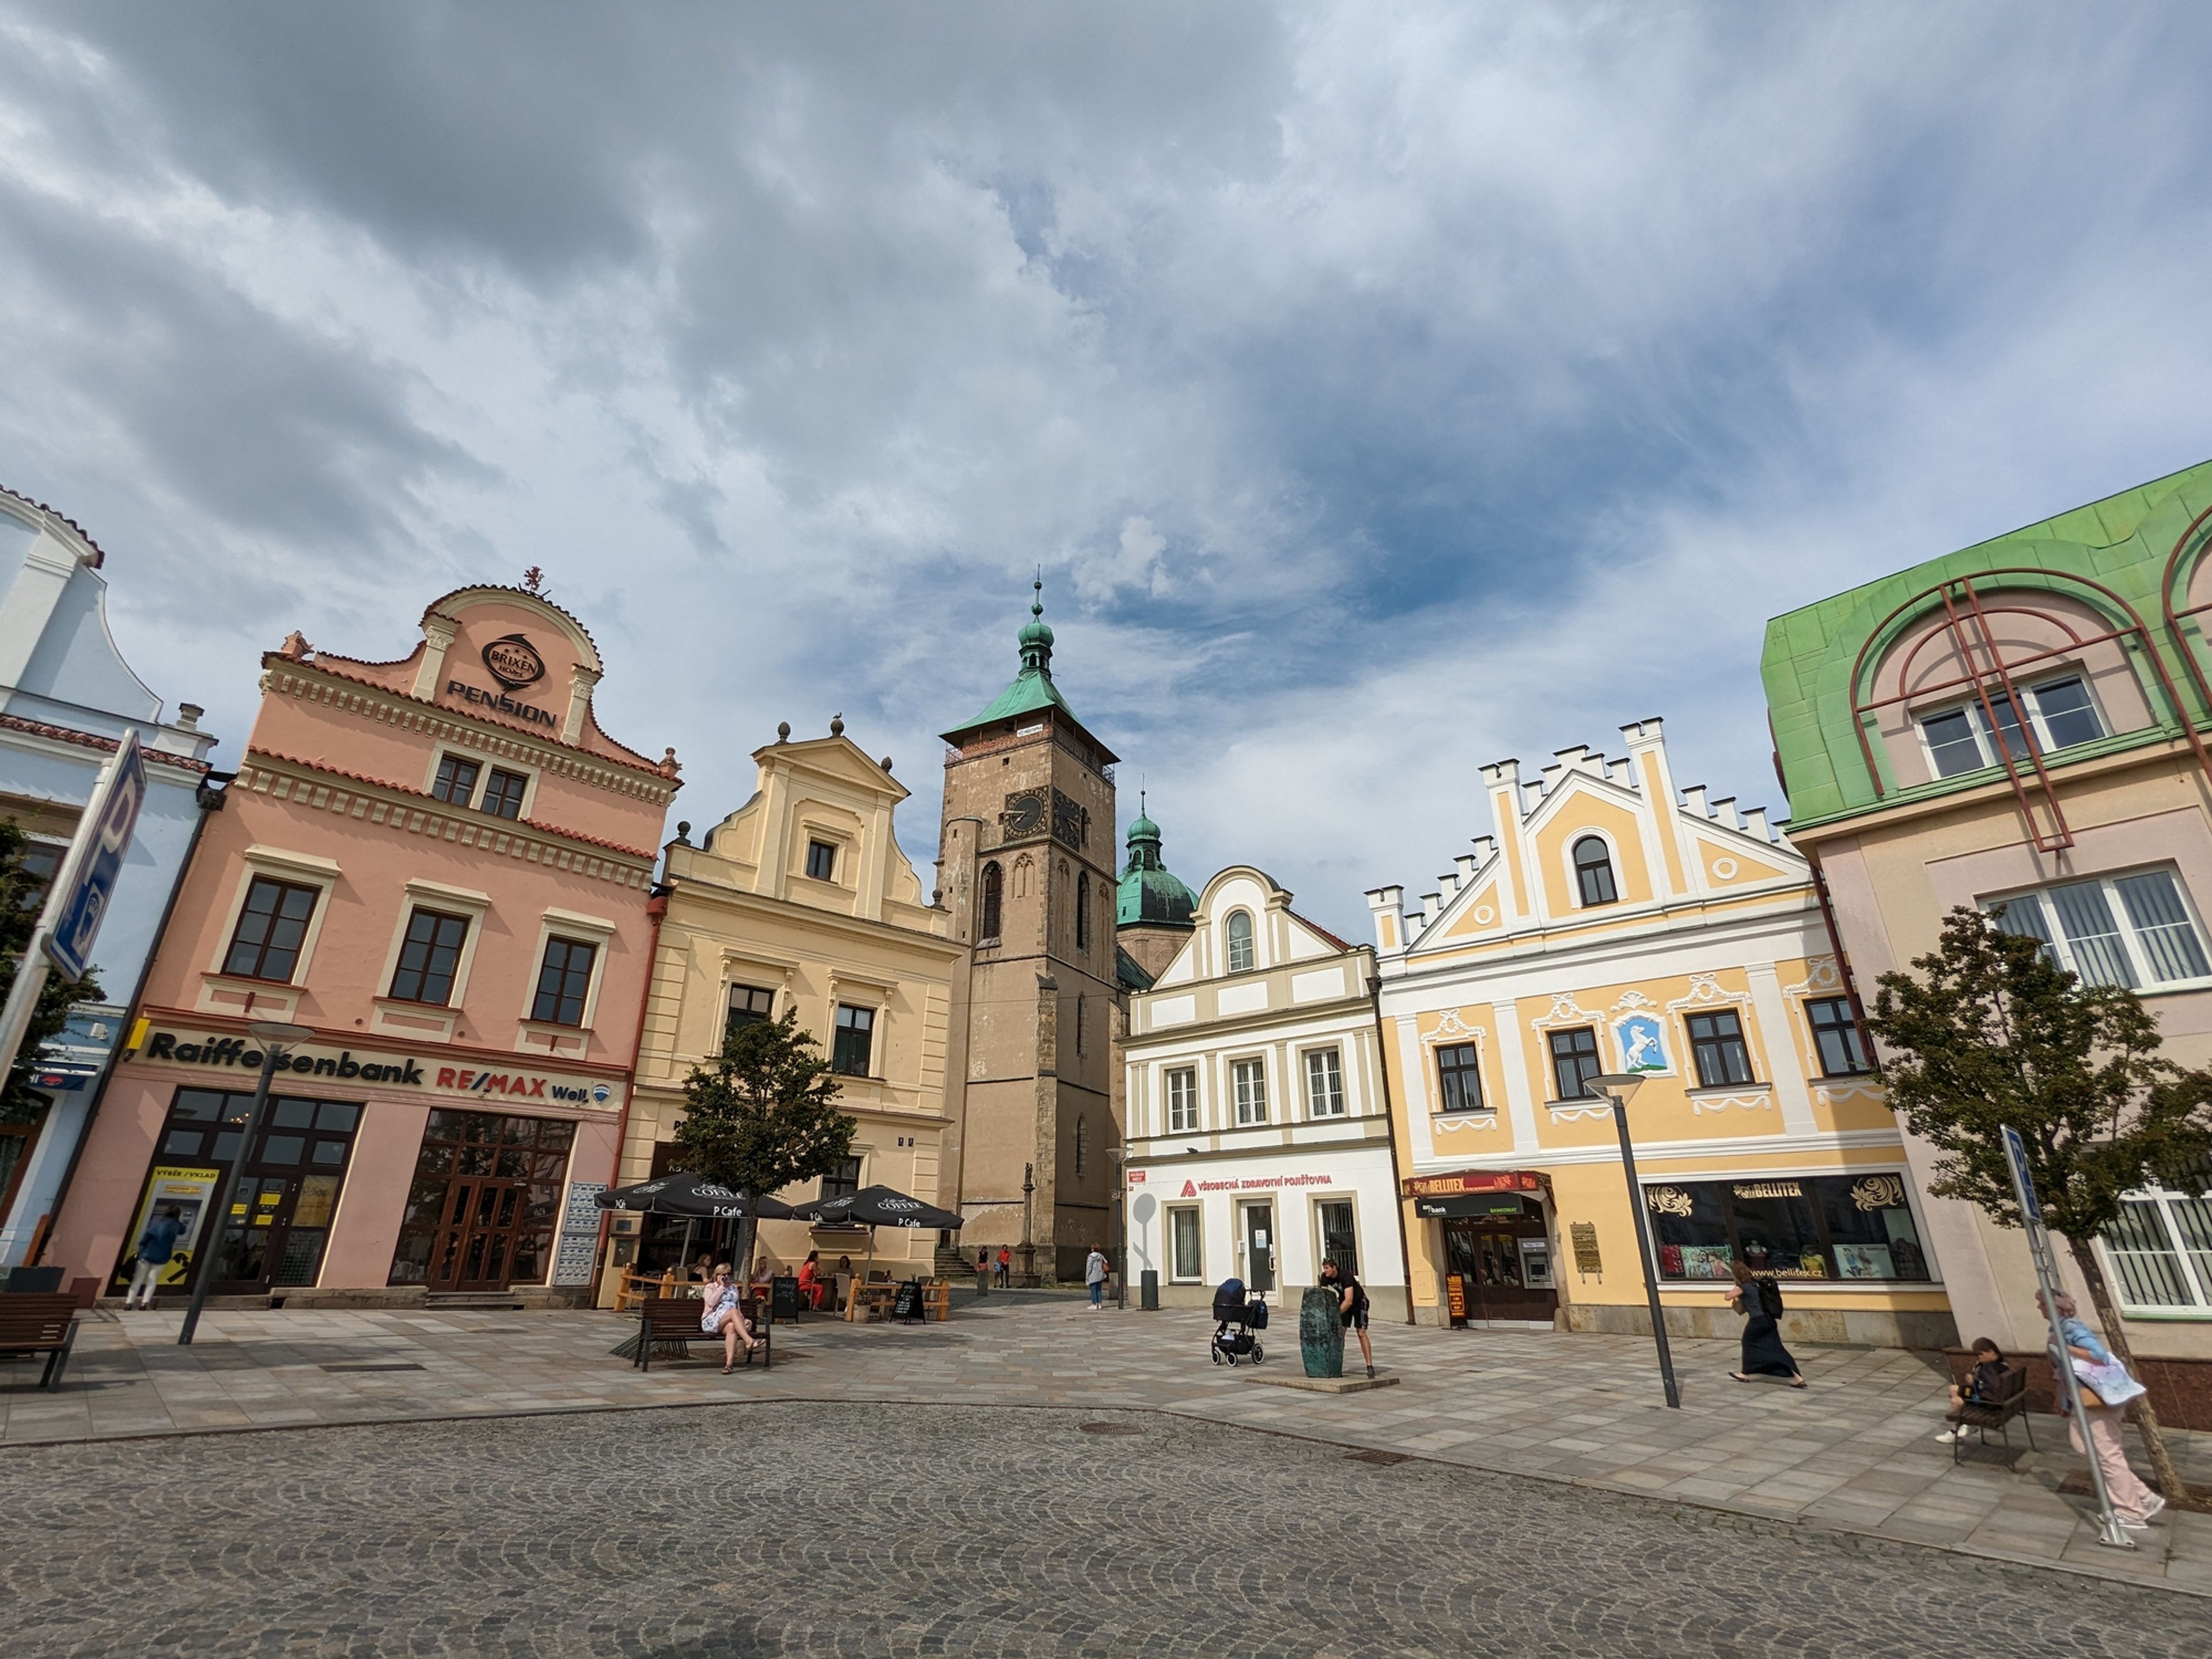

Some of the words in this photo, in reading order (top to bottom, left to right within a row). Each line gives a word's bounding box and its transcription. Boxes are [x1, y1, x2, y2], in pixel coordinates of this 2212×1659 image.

[491, 650, 537, 674] BRIXEN
[498, 665, 524, 678] HOTEL
[446, 680, 557, 728] PENSION
[85, 772, 136, 887] P
[147, 1032, 425, 1085] Raiffesenbank
[436, 1067, 547, 1097] RE/MAX
[552, 1085, 588, 1102] Well
[157, 1169, 183, 1177] VÝBĚR
[1198, 1179, 1239, 1191] VŠEOBECNÁ
[1241, 1175, 1283, 1189] ZDRAVOTNÍ
[1284, 1173, 1332, 1186] POJIŠŤOVNA
[1429, 1178, 1466, 1192] BELLITEX
[1753, 1182, 1802, 1198] BELLITEX
[713, 1206, 720, 1216] P
[721, 1206, 742, 1217] Cafe
[878, 1202, 924, 1210] COFFEE
[898, 1218, 904, 1226] P
[904, 1217, 921, 1228] Cafe
[1751, 1267, 1823, 1278] www.bellitex.cz
